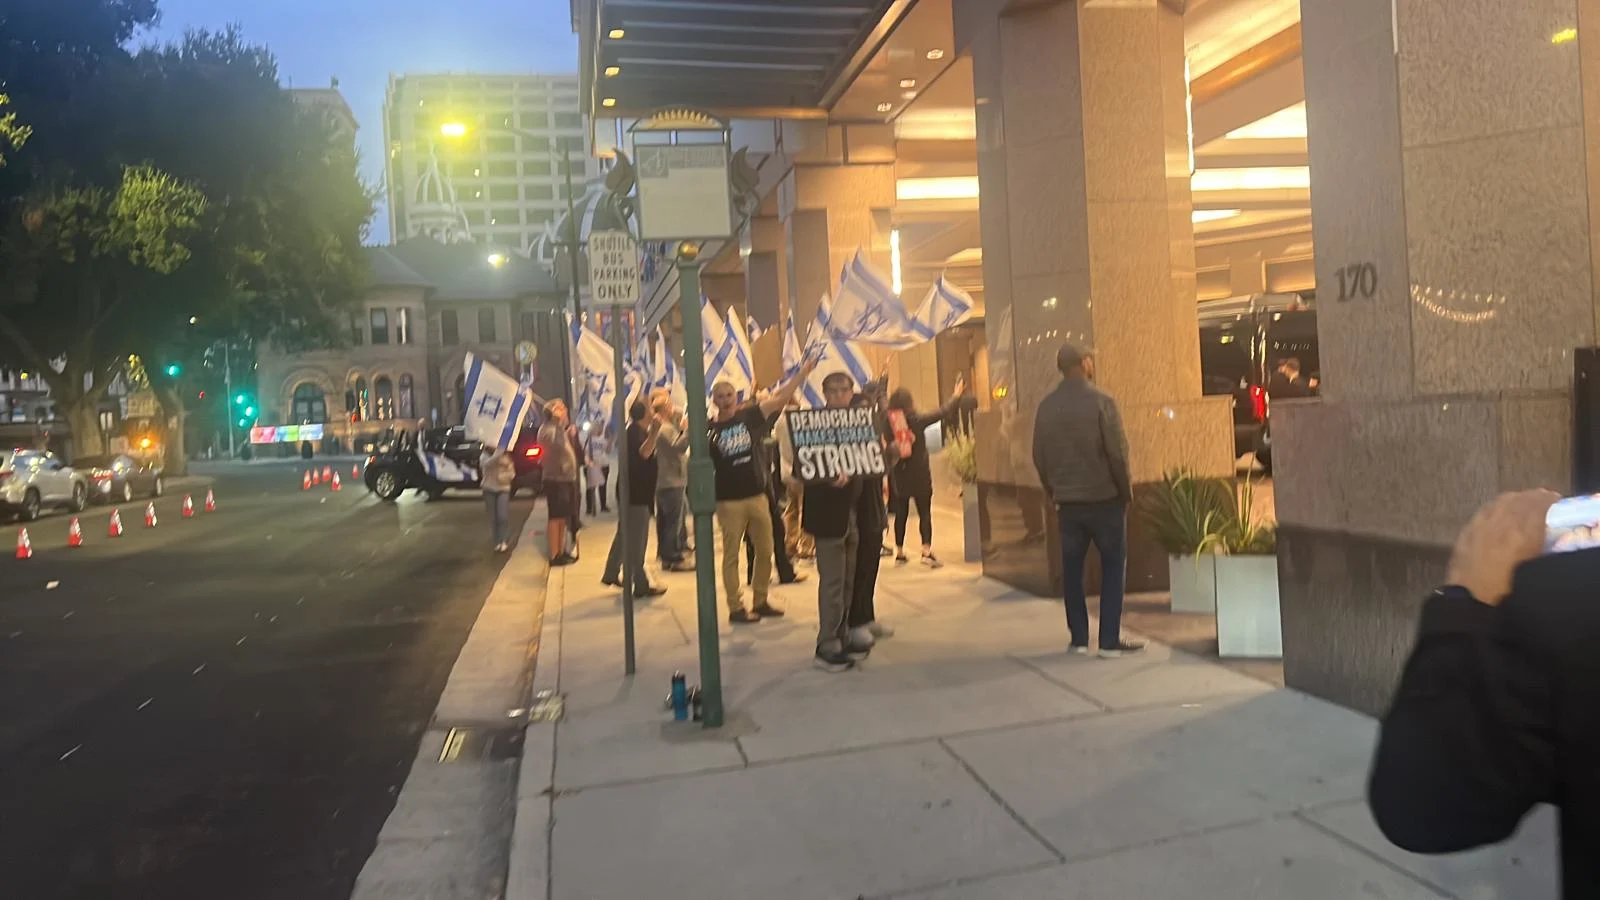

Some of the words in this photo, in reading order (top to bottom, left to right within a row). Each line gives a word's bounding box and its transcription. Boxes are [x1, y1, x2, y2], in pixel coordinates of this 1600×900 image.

[593, 235, 631, 251] SHUTTLE
[603, 251, 624, 266] BUS
[593, 267, 636, 280] PARKING
[1333, 261, 1377, 303] 170
[598, 283, 632, 299] ONLY
[790, 407, 873, 432] DEMOCRACY
[798, 440, 885, 480] STRONG
